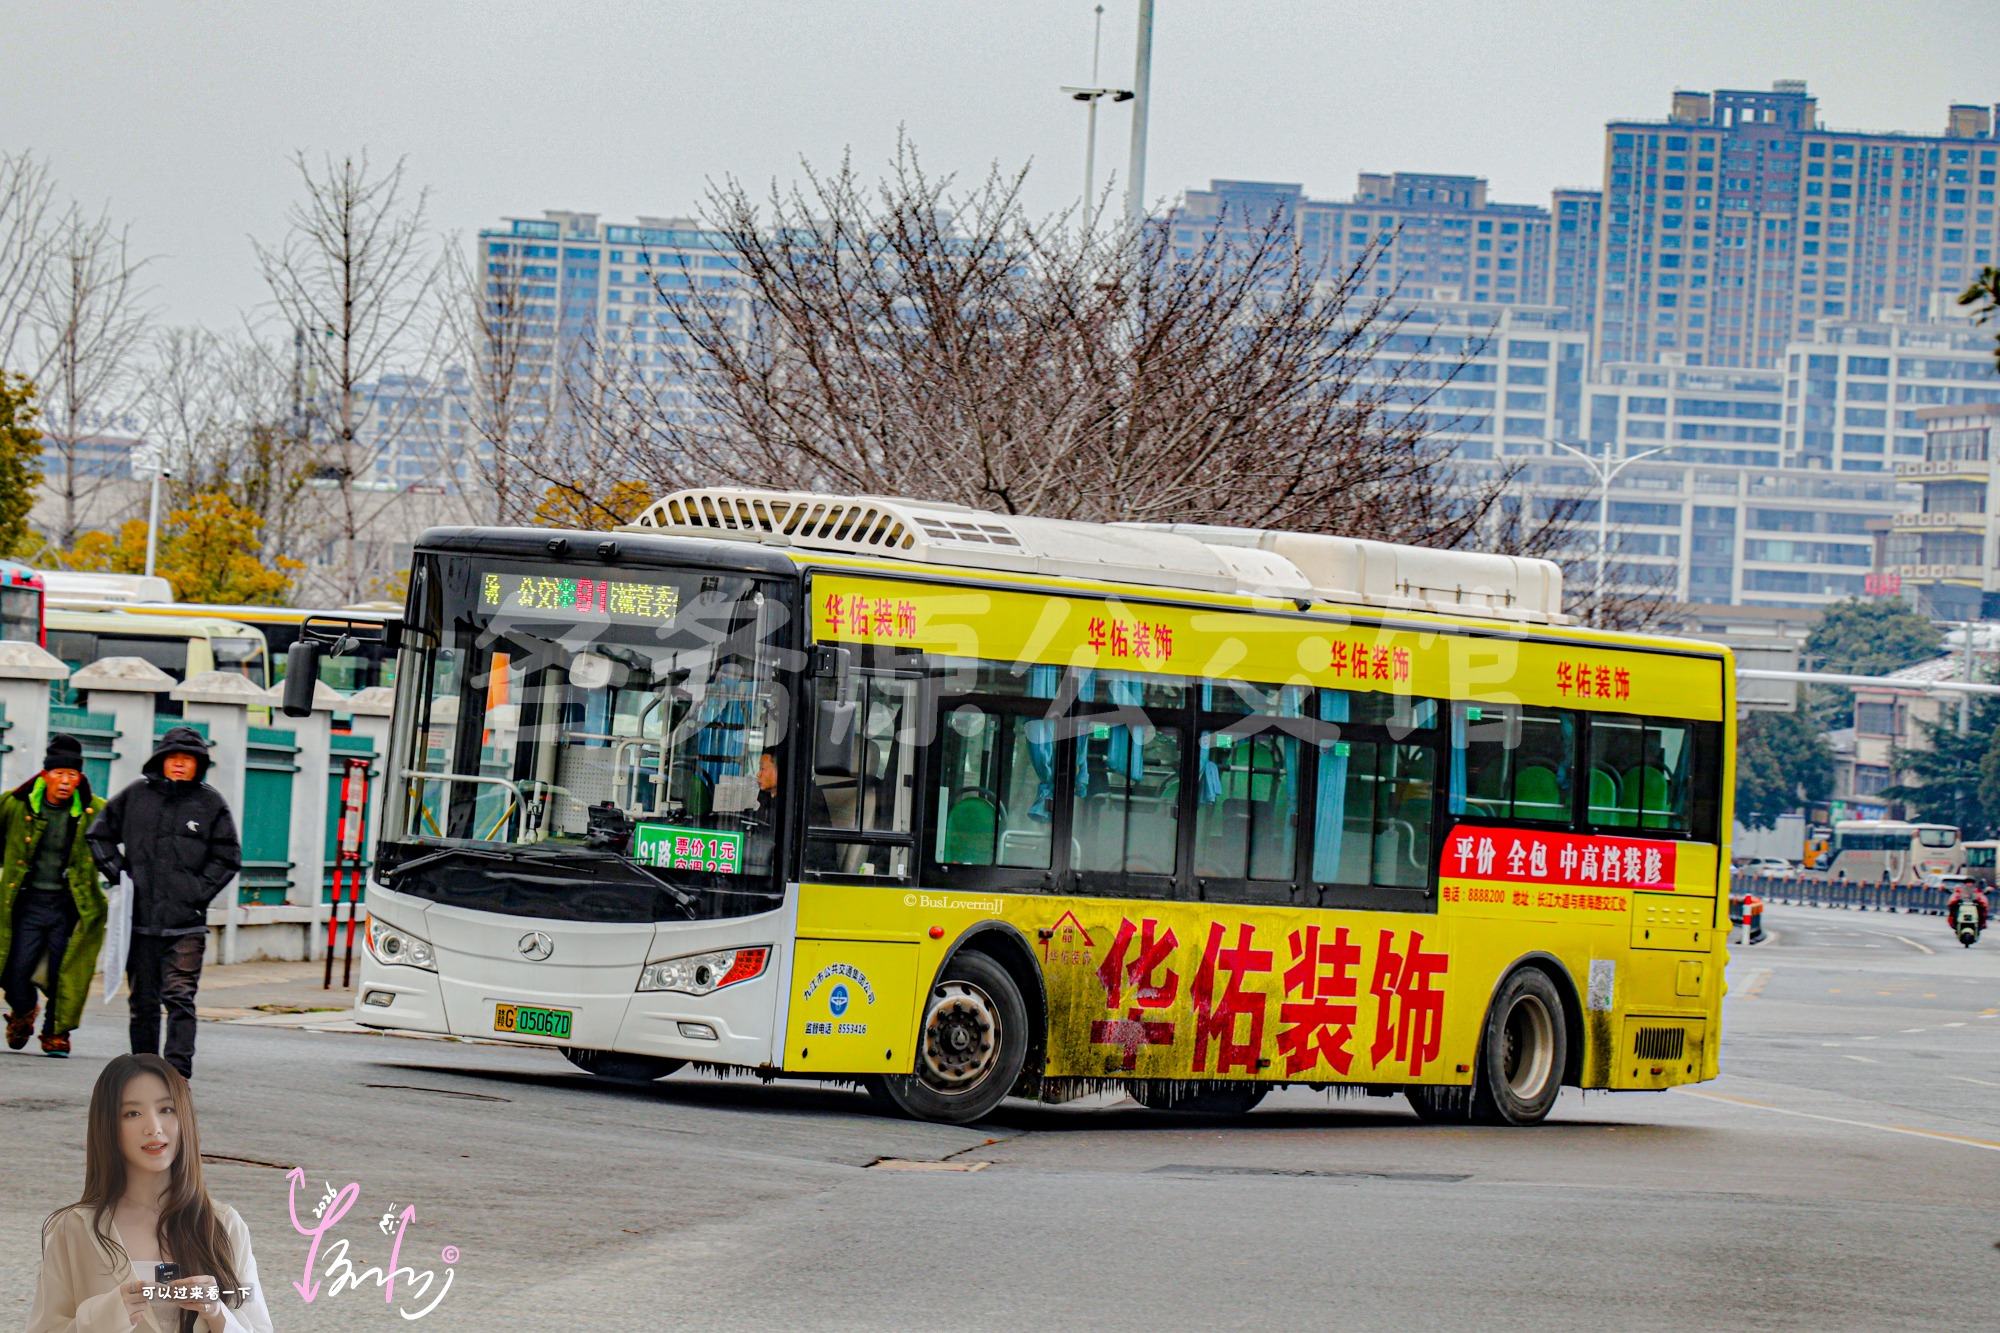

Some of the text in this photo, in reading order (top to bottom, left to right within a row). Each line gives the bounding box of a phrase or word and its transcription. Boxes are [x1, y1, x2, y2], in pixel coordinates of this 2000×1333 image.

[824, 593, 917, 640] 华佑装饰
[1087, 617, 1173, 661] 华佑装饰
[1330, 640, 1409, 684] 华佑装饰
[1556, 661, 1631, 701] 华佑装饰
[1453, 835, 1663, 884] 平价 全包 中高档装修
[803, 962, 876, 1005] 九江市公共交通集团公司
[1089, 916, 1450, 1079] 华佑装饰
